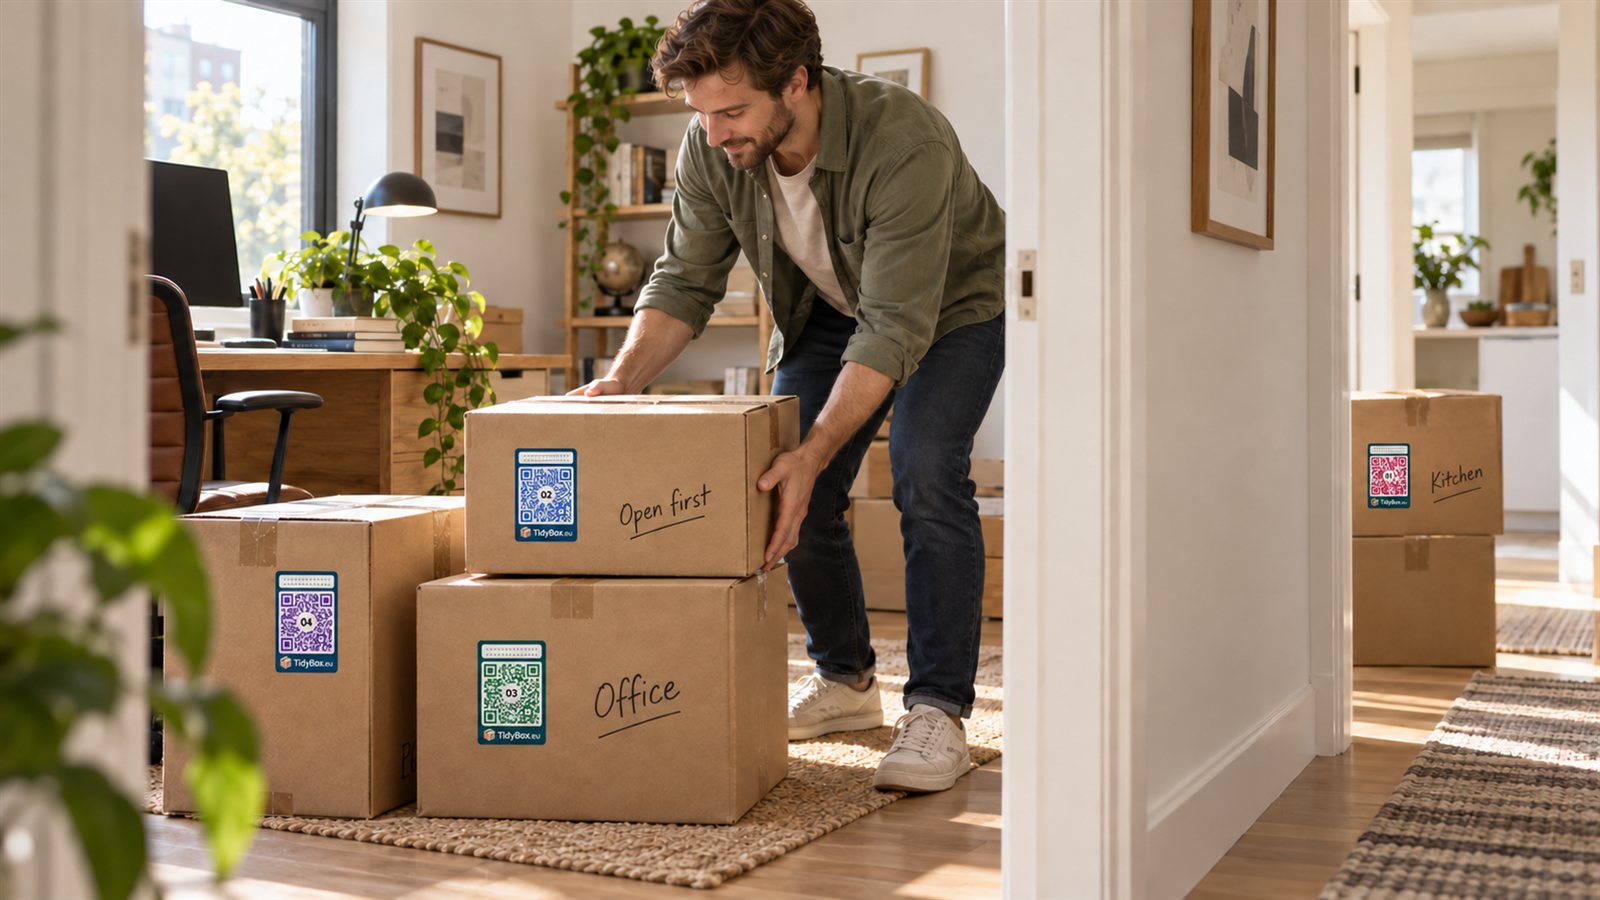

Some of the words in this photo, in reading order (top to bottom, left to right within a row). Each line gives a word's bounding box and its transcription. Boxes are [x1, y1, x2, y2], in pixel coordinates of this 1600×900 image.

[1431, 465, 1483, 494] Kitchen
[540, 490, 552, 499] 02
[620, 503, 663, 534] Open
[670, 483, 711, 517] first
[533, 529, 573, 538] TidyBox.eu
[300, 617, 313, 627] 04
[293, 658, 334, 669] TidyBox.eu
[505, 689, 518, 698] 03
[594, 673, 681, 718] Office
[497, 731, 541, 741] TidyBox.eu
